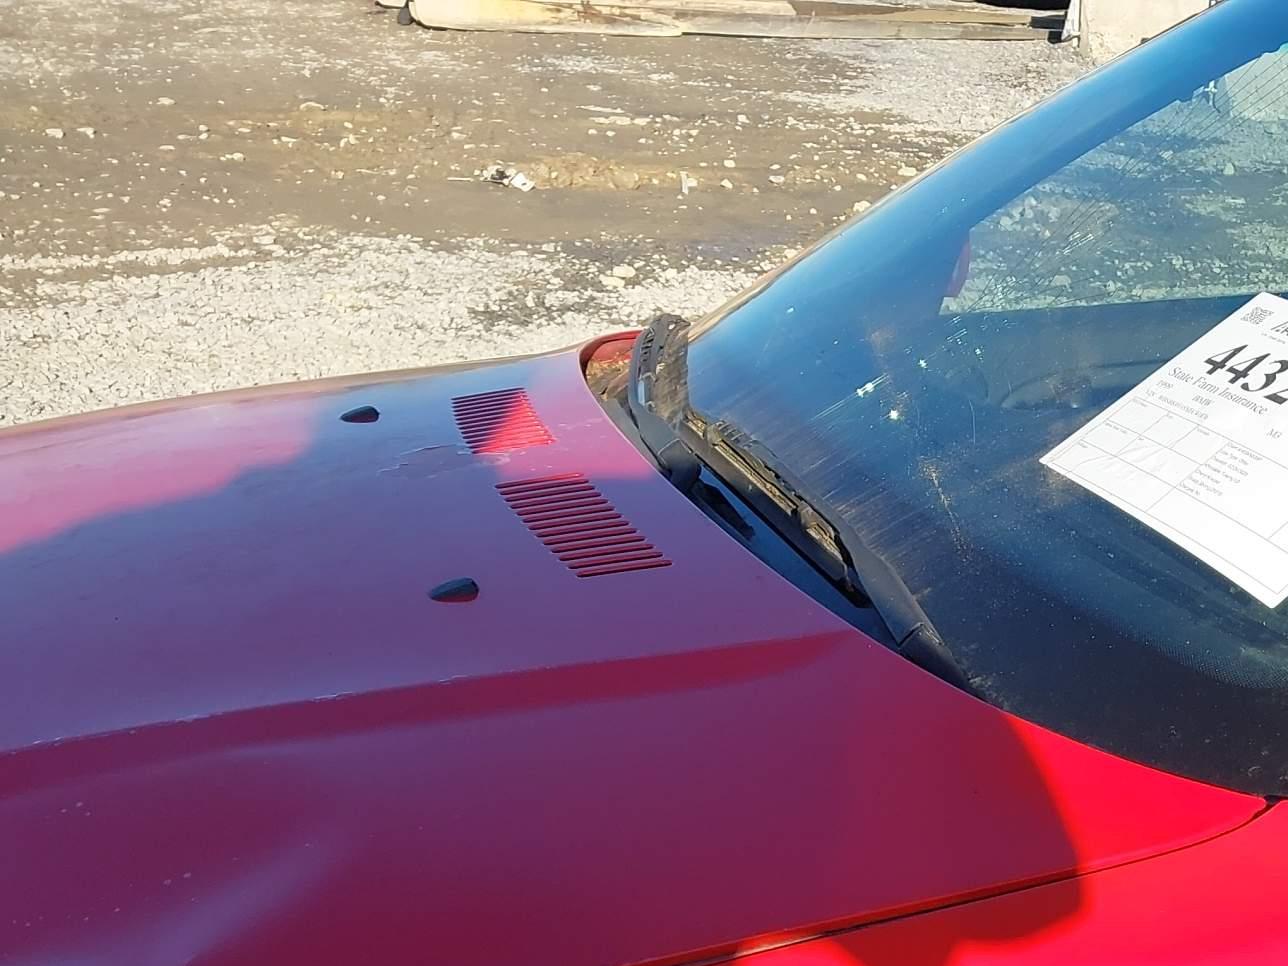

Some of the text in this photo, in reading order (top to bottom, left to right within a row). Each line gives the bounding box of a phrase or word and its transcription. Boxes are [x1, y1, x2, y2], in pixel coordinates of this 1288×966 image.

[1168, 366, 1195, 384] State
[1192, 376, 1220, 394] Farm
[1219, 387, 1268, 415] Insurance
